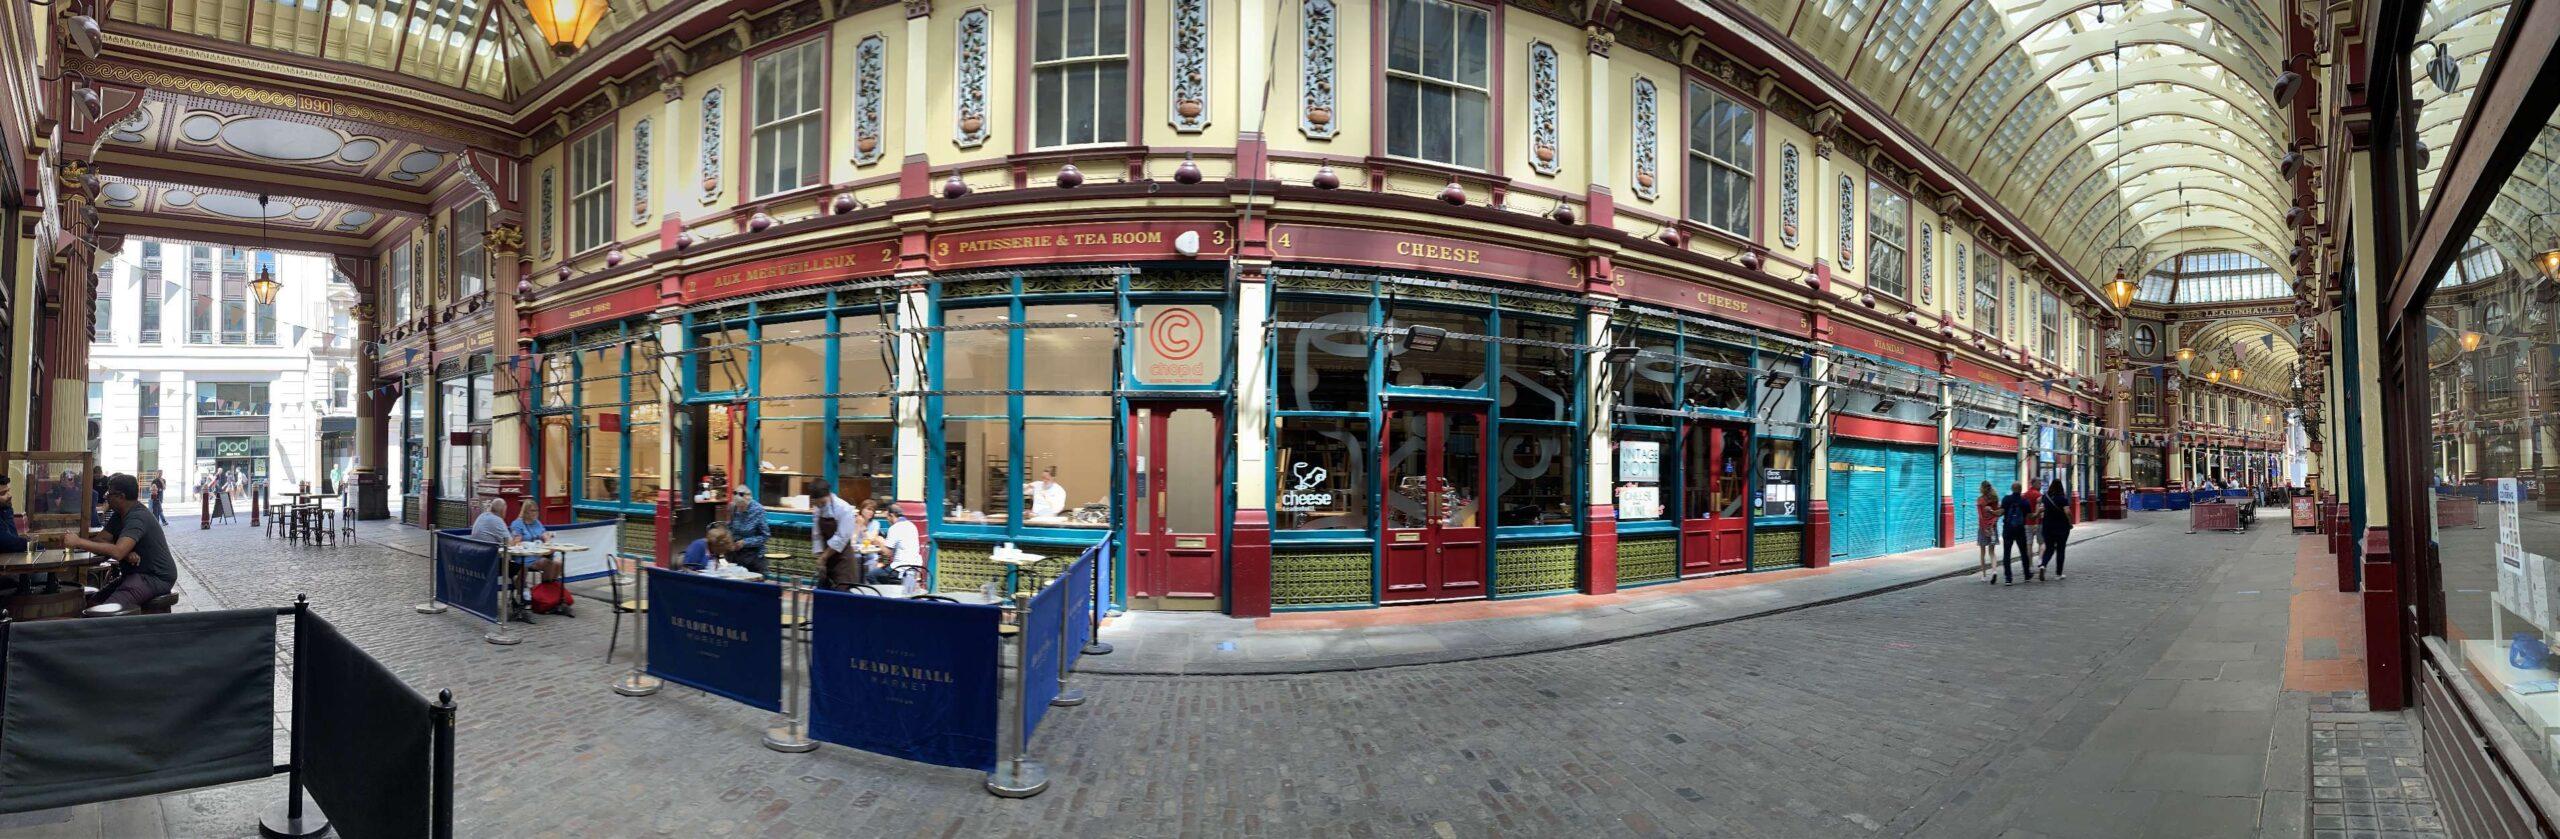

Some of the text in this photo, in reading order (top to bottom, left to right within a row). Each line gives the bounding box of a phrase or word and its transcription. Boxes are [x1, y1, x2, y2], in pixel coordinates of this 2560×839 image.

[300, 96, 330, 113] 1990
[938, 230, 1225, 256] 3 PATISSERIE & TEA ROOM 3
[1277, 232, 1578, 280] 4 CHEESE 4
[714, 275, 741, 288] AUX
[746, 253, 857, 282] MERVEILLEUX
[881, 249, 892, 262] 2
[1615, 275, 1807, 328] 5 CHEESE 5
[2205, 306, 2273, 316] LEADENHALL
[1873, 338, 1905, 356] VIANDAS
[218, 439, 249, 455] pod
[1282, 490, 1332, 506] cheese
[850, 657, 954, 683] LEADENHALL
[870, 676, 927, 692] MARKET
